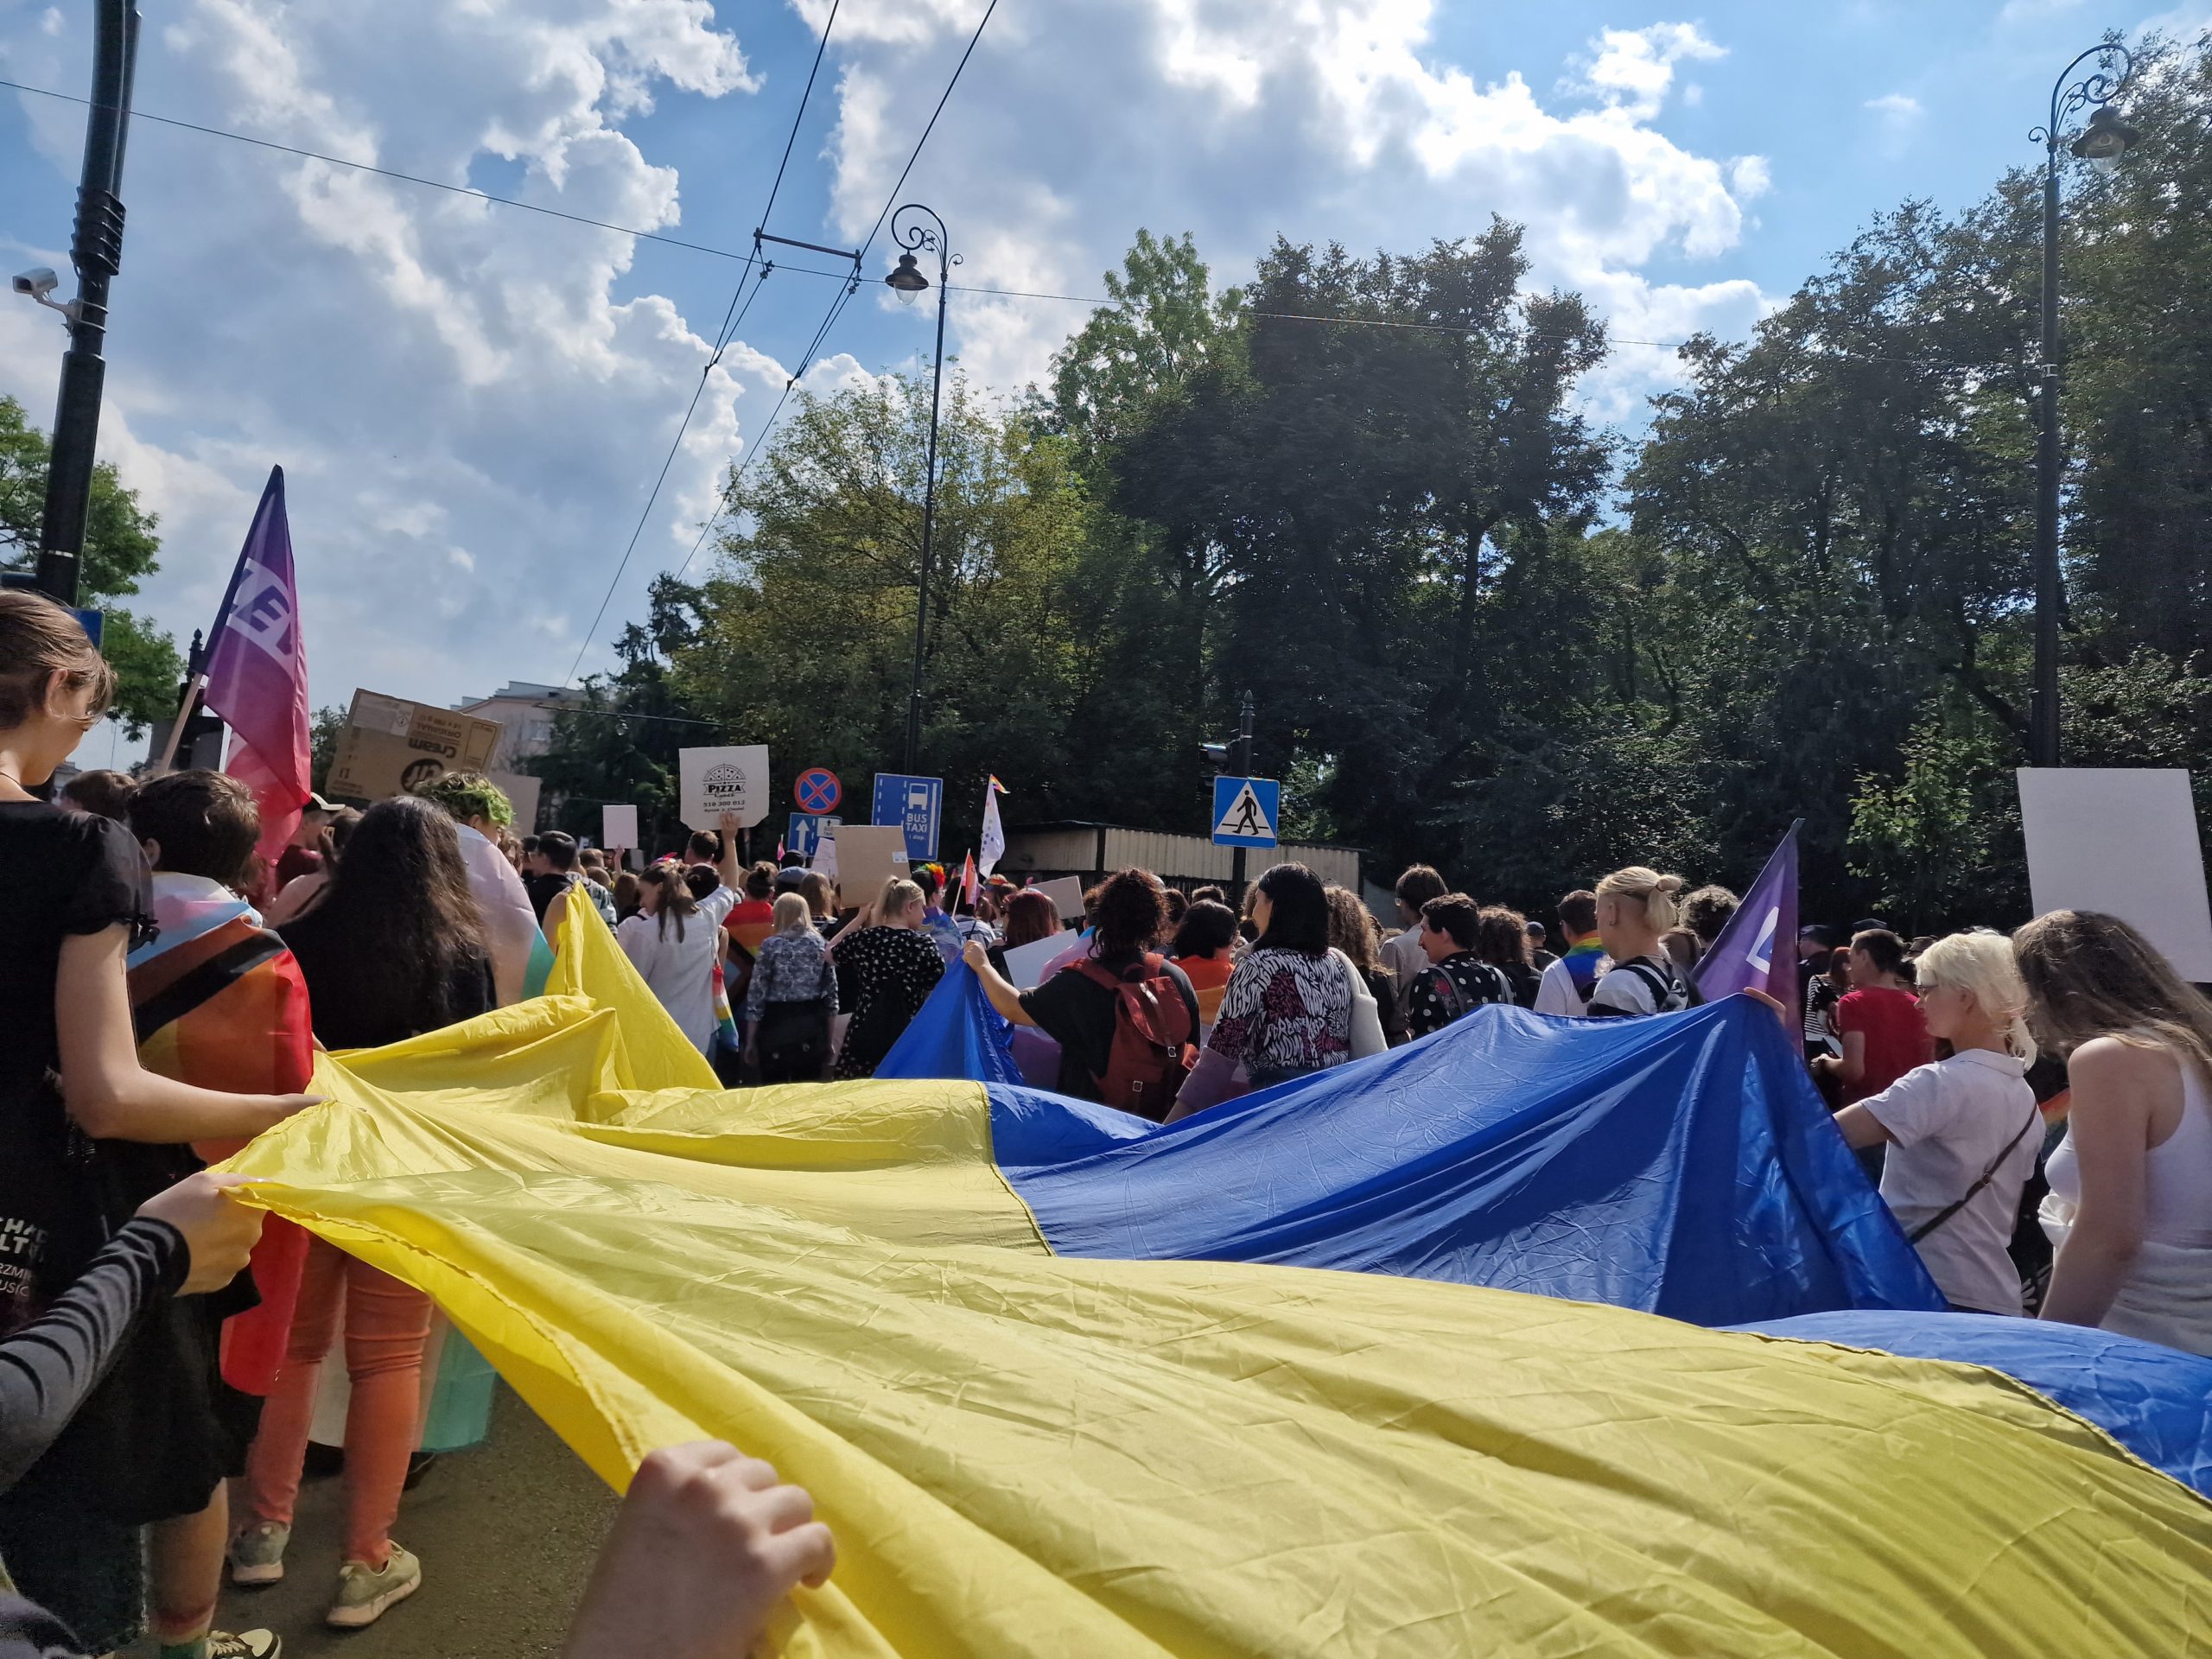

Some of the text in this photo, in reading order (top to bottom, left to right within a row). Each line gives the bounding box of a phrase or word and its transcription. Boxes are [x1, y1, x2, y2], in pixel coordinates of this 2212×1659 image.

[416, 722, 461, 739] ORIGINAL
[408, 737, 456, 759] Cream
[708, 785, 741, 793] PIZZA
[906, 812, 927, 823] BUS
[906, 822, 928, 833] TAXI
